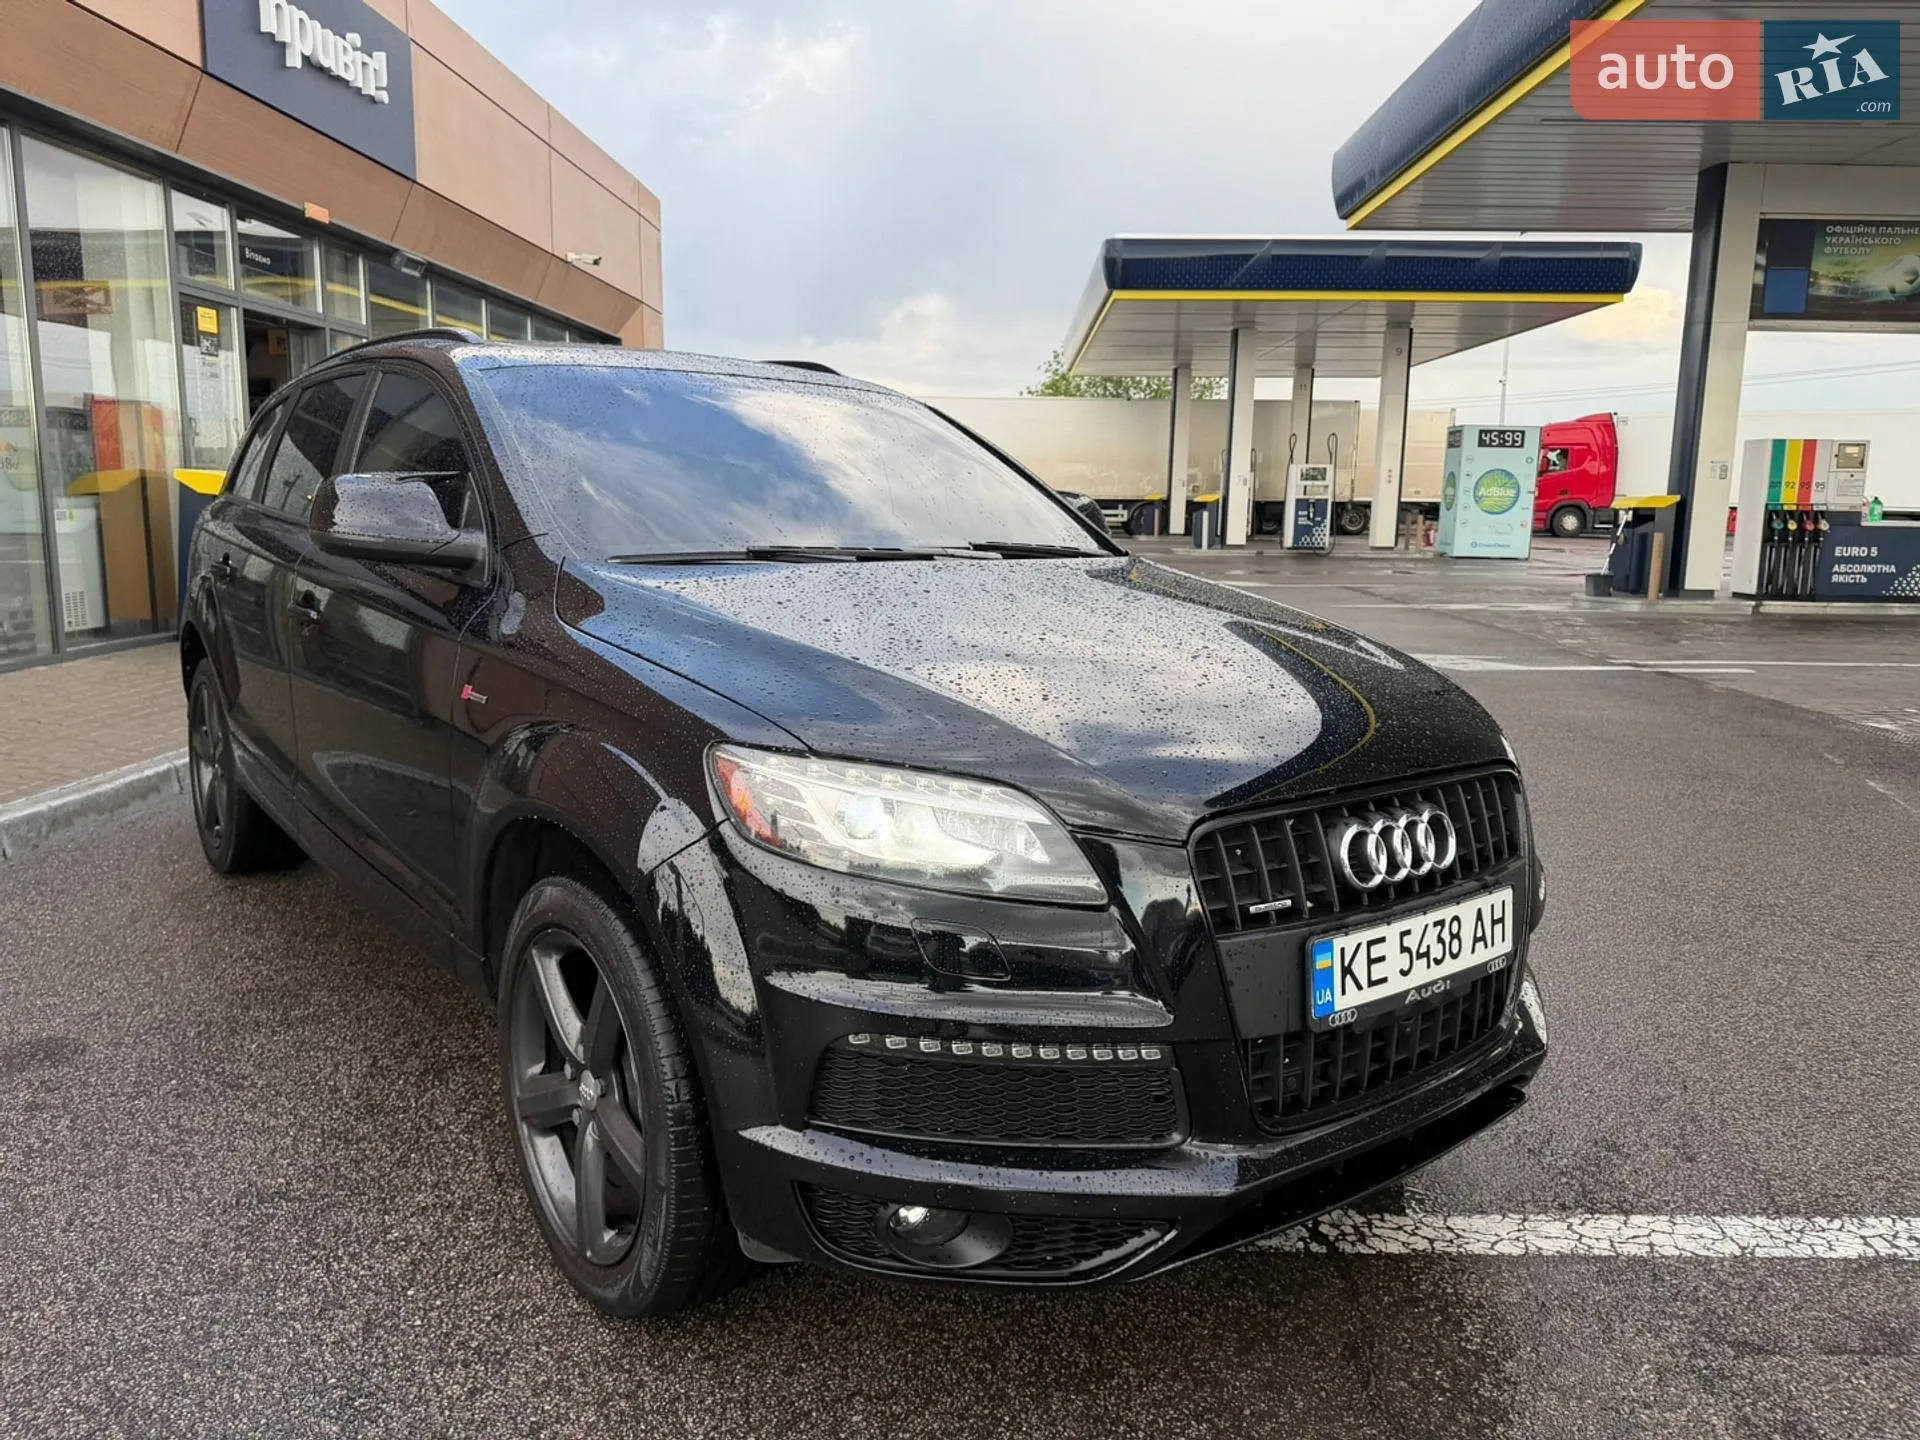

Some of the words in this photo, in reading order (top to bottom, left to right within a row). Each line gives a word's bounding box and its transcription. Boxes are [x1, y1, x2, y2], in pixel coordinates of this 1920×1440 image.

[1825, 224, 1877, 234] ОФІЦІЙНЕ
[1879, 226, 1920, 235] ПАЛЬНЕ
[1825, 235, 1901, 245] УКРАЇНСЬКОГО
[1824, 246, 1872, 255] ФУТБОЛУ
[1784, 481, 1796, 490] 92
[1800, 481, 1811, 490] 95
[1814, 481, 1826, 491] 95
[1834, 547, 1868, 557] EURO
[1870, 547, 1879, 557] 5
[1832, 564, 1897, 574] АБСОЛЮТНА
[1831, 574, 1868, 584] ЯКІСТЬ
[1340, 936, 1388, 996] KE
[1399, 914, 1463, 977] 5438
[1470, 899, 1506, 954] AH
[1316, 987, 1333, 1005] UA
[1404, 980, 1450, 1005] Audi
